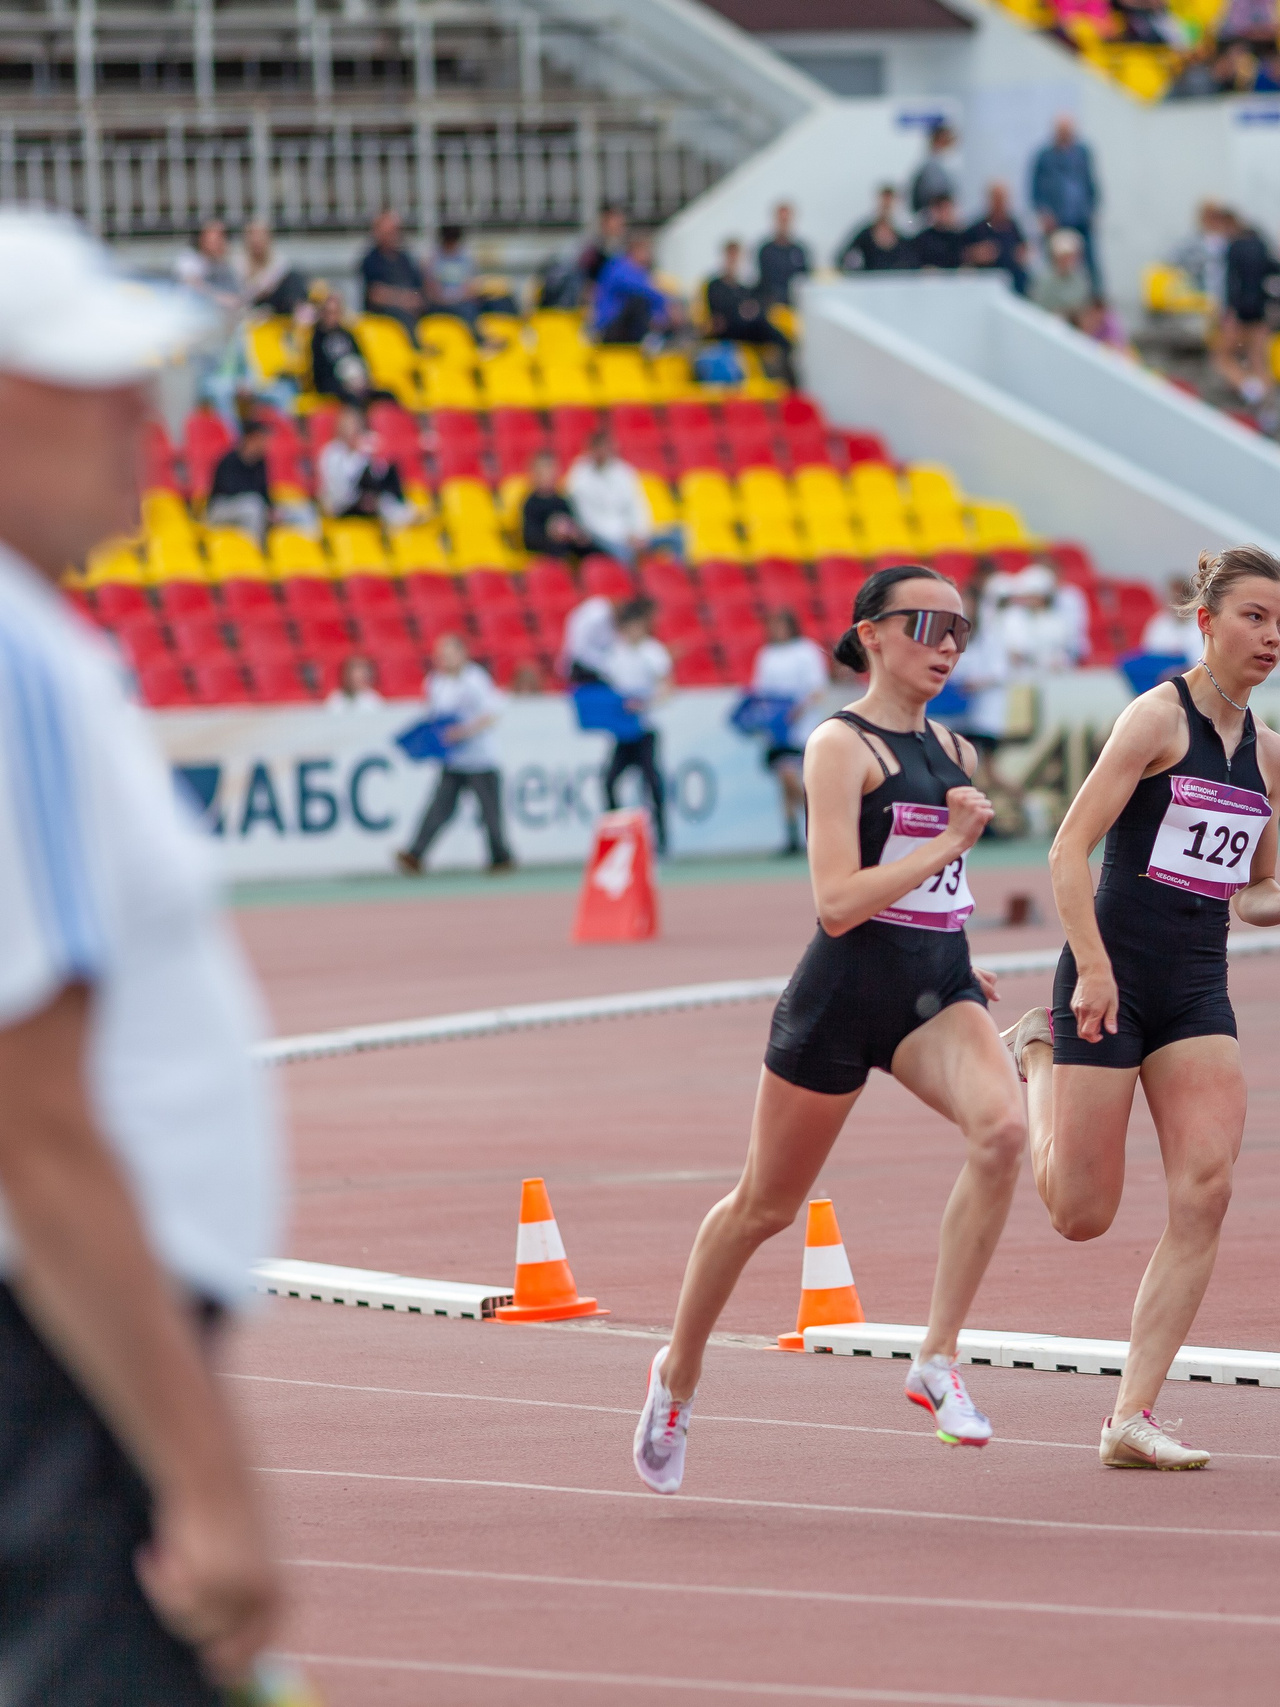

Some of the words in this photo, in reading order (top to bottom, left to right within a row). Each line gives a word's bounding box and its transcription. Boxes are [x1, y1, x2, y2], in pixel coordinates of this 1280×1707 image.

[239, 757, 394, 834] АБС
[1181, 784, 1218, 797] ЧЕМПИОНАТ
[1182, 820, 1250, 868] 129
[1155, 871, 1190, 887] ЧЕБОКСАРЫ
